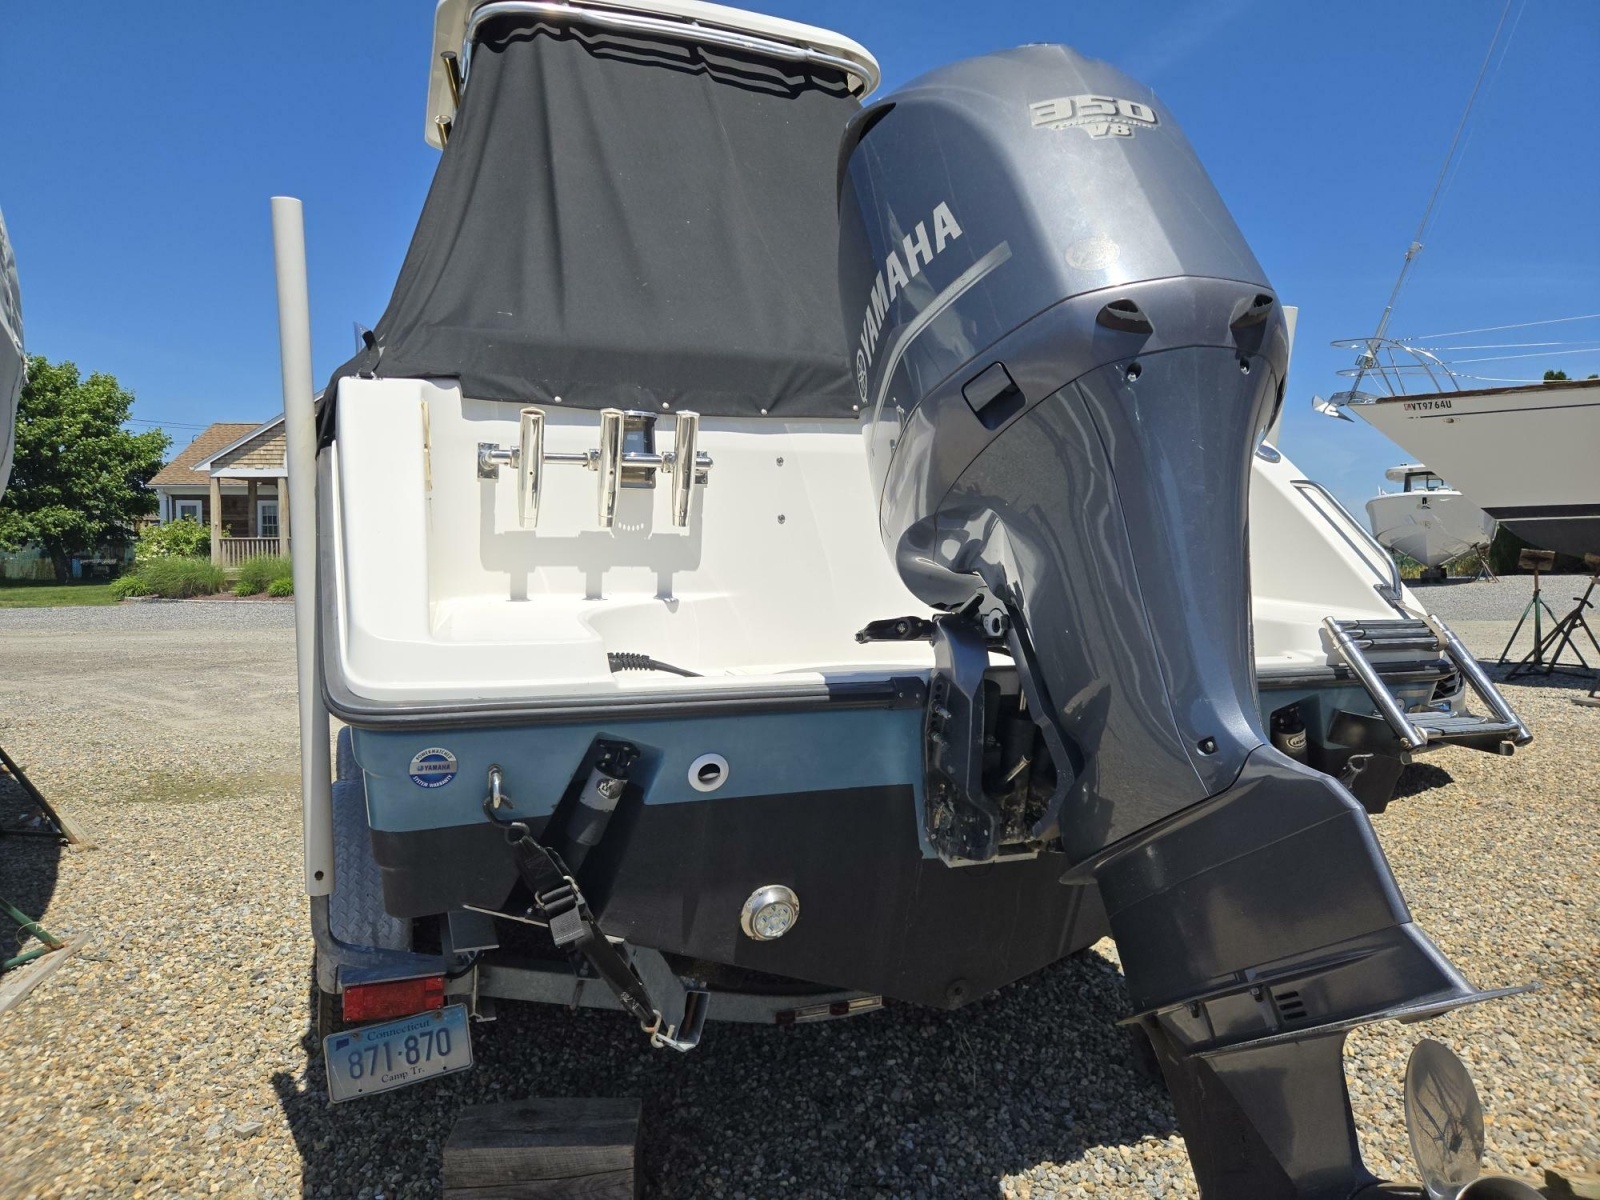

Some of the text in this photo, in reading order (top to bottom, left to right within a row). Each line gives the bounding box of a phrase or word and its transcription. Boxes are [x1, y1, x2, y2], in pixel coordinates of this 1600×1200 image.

[1029, 94, 1156, 126] 350
[1087, 122, 1132, 138] V8
[861, 201, 963, 367] YAMAHA
[367, 1019, 431, 1042] Connecticut
[381, 1066, 425, 1083] Camp Tr.
